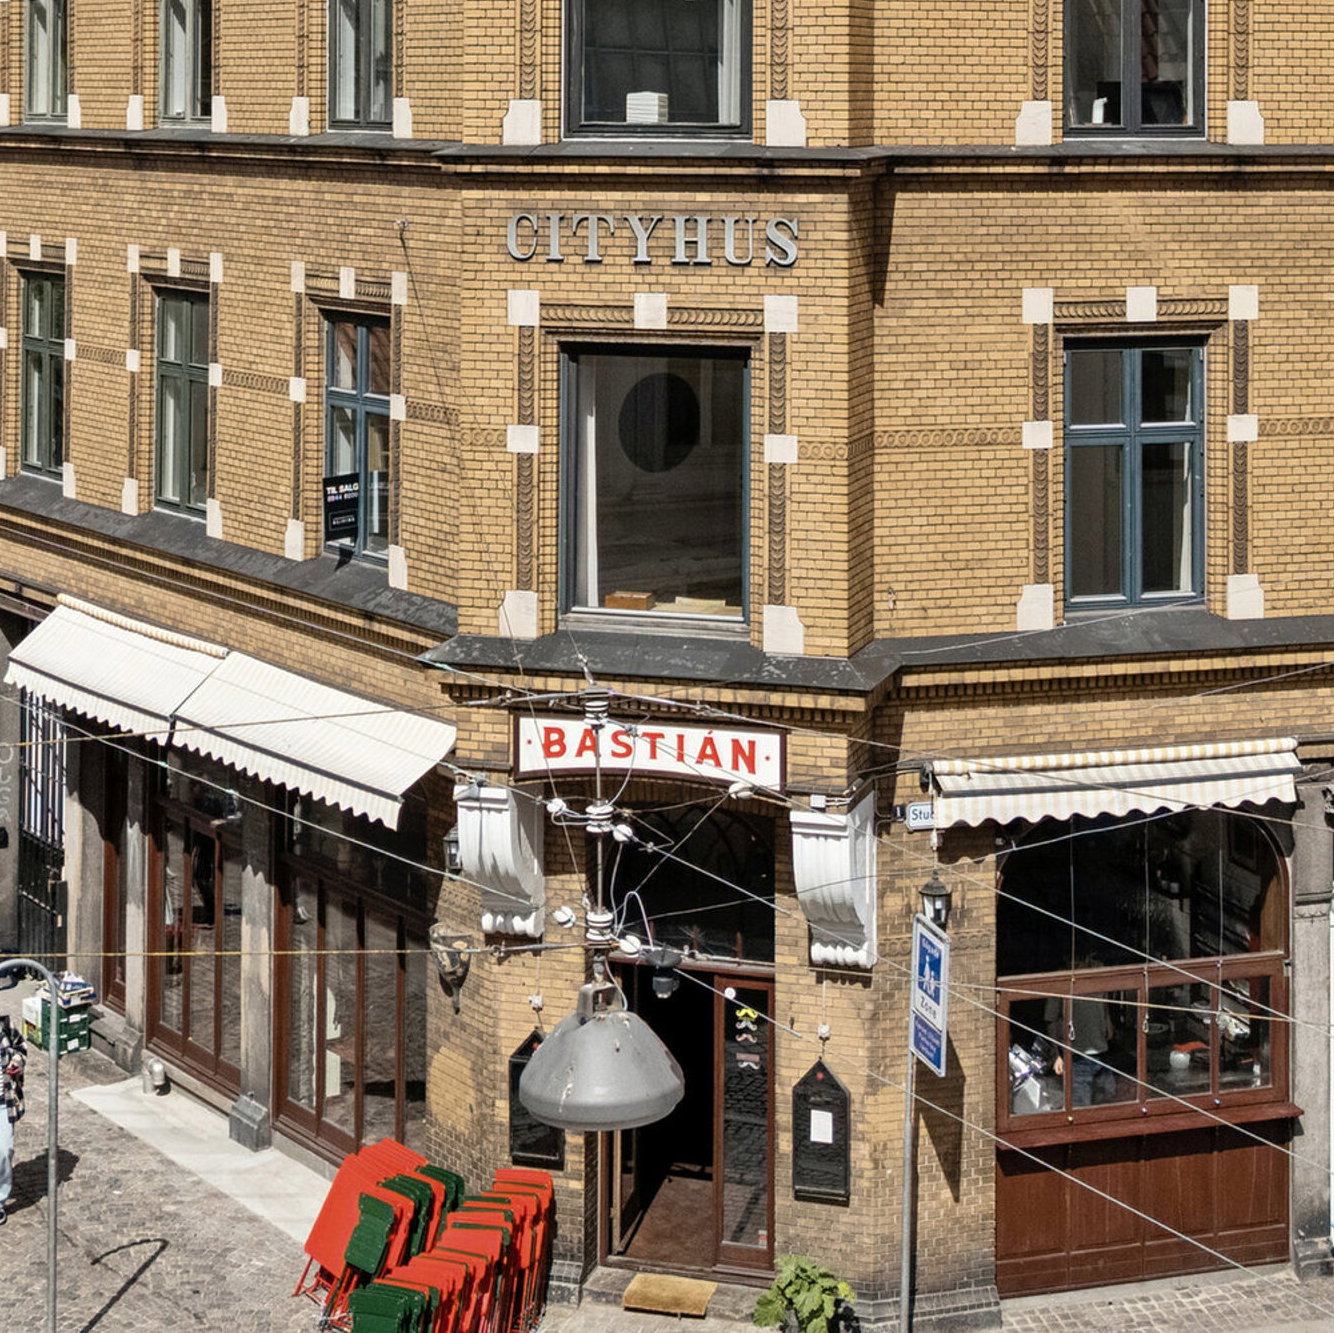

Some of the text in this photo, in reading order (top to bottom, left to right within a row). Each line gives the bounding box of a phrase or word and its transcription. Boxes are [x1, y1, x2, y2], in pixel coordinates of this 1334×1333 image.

[506, 213, 799, 266] CITYHUS
[326, 482, 359, 495] TIL SALG
[542, 726, 757, 775] BASTIÁN
